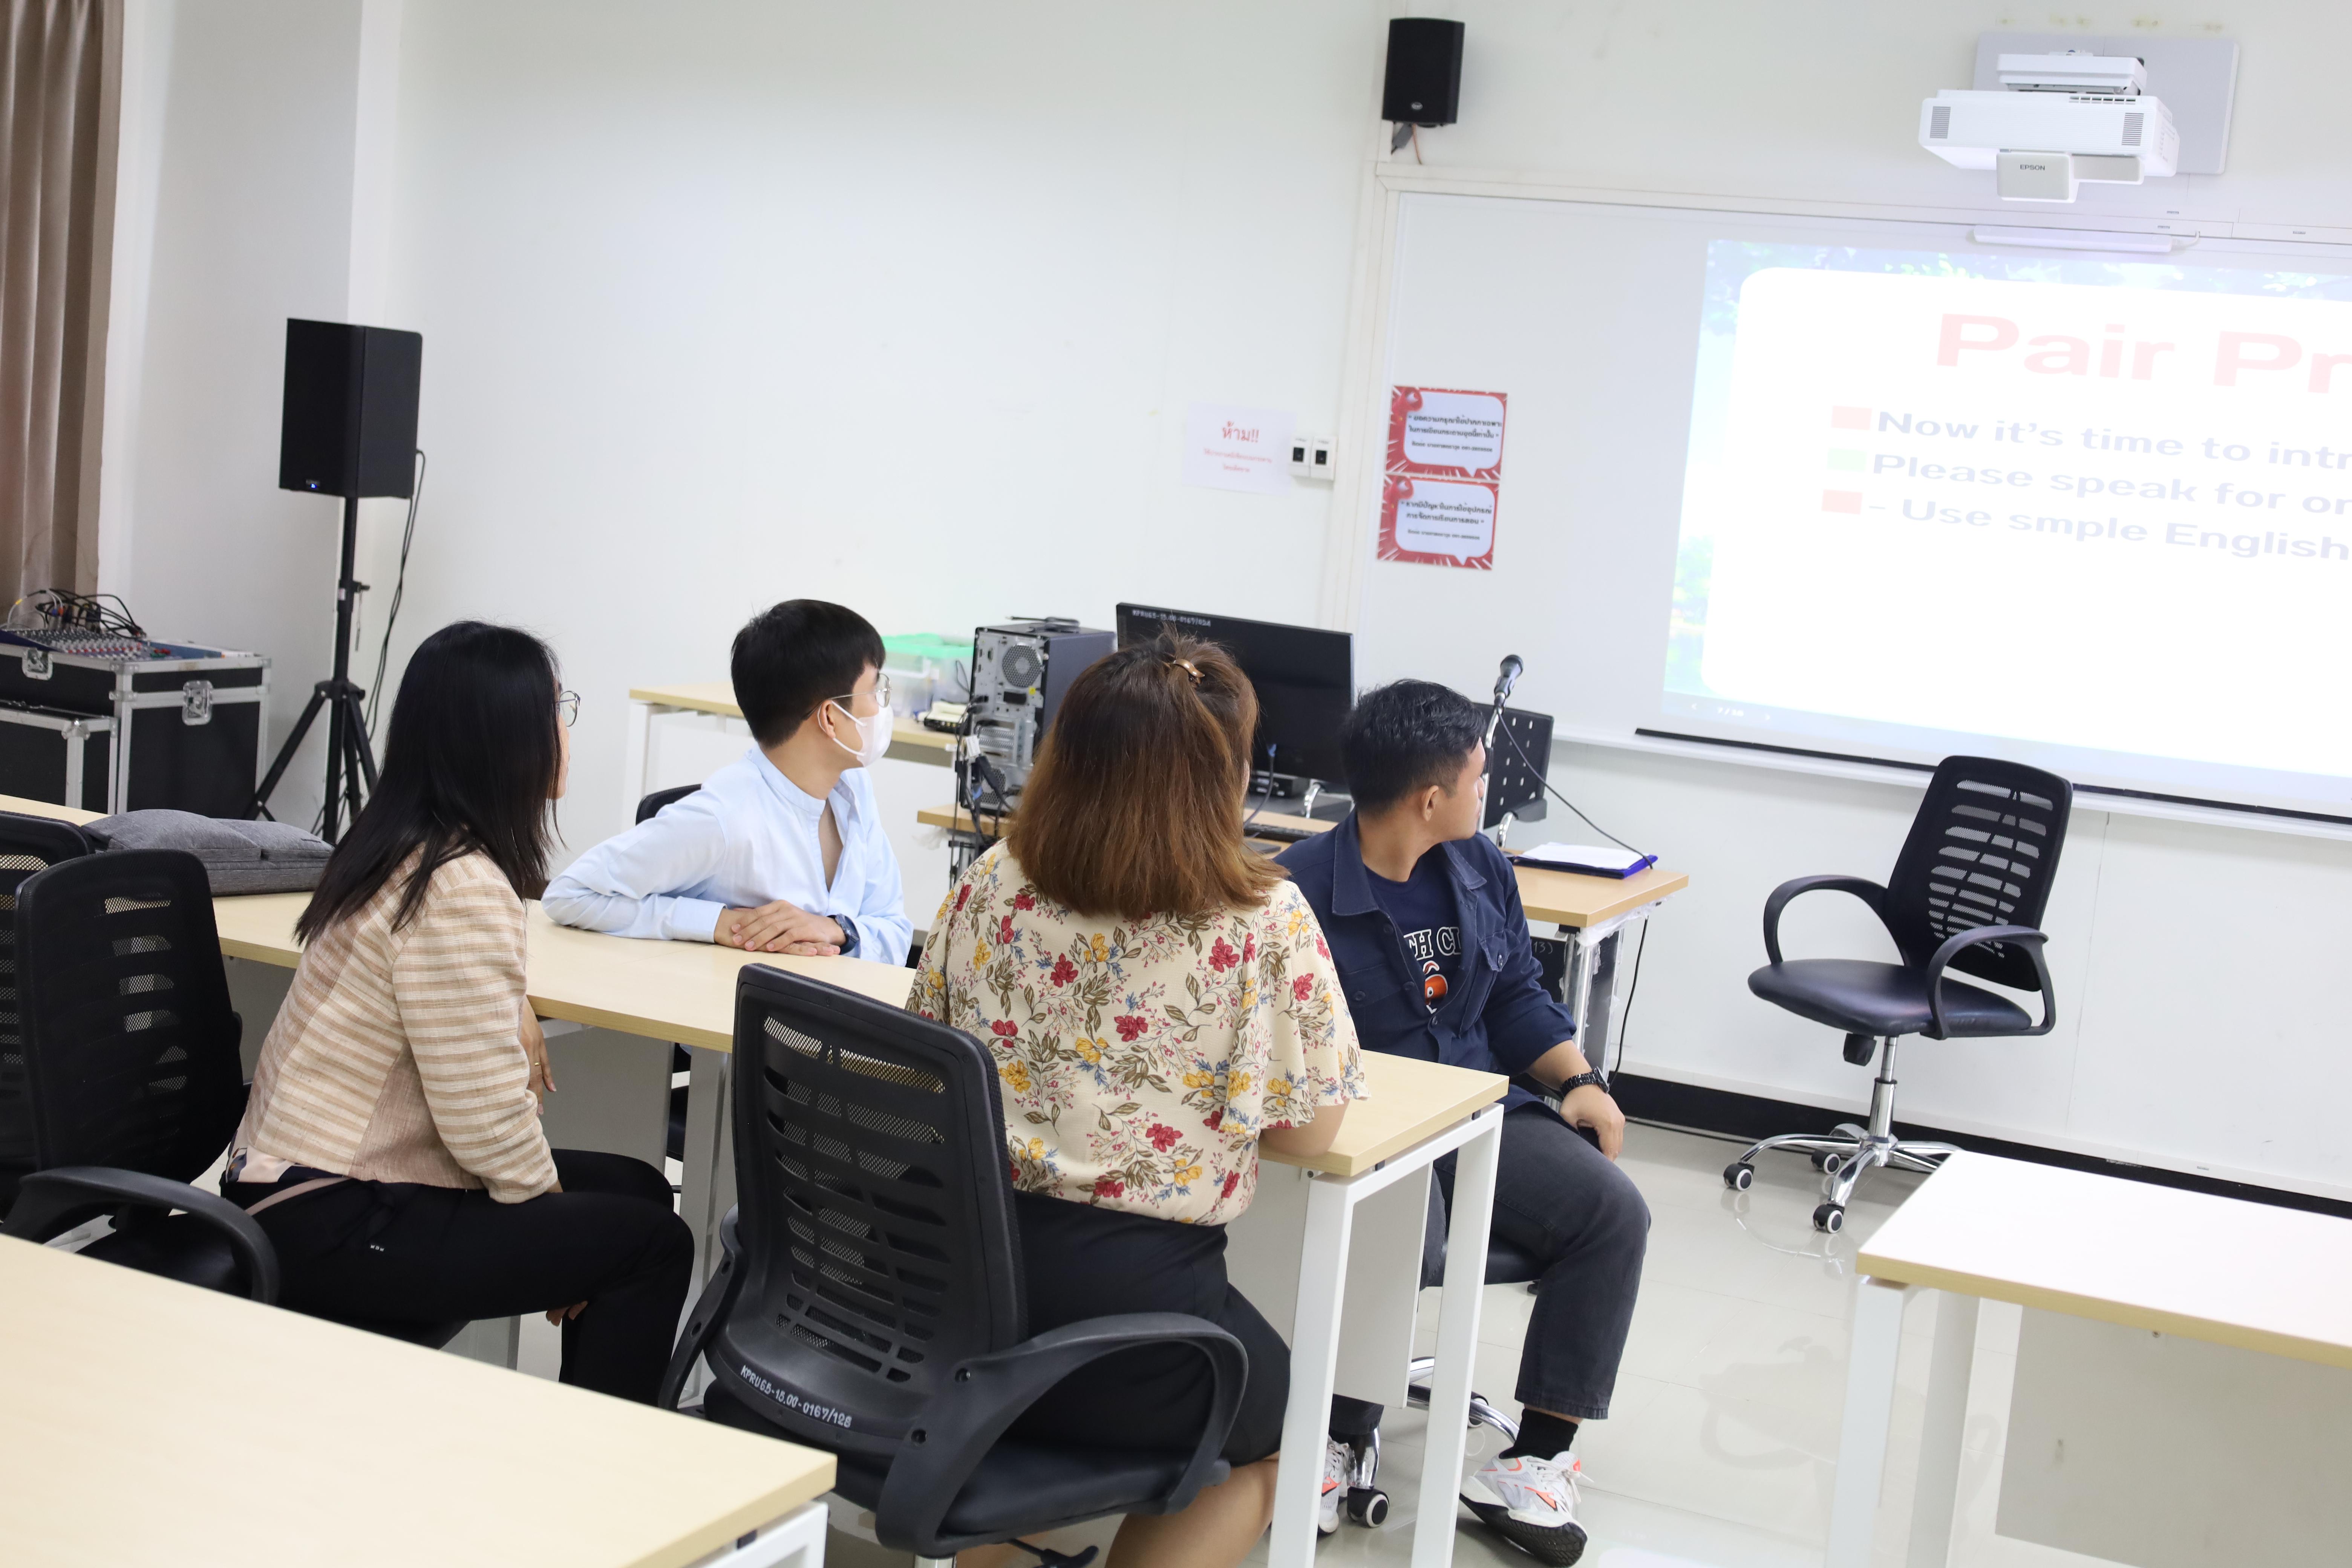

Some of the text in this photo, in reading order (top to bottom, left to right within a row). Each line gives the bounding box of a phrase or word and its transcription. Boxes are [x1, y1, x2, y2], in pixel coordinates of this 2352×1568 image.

[1936, 313, 2175, 381] Pair
[1222, 421, 1259, 443] ห้าม!!
[1878, 411, 1979, 439] Now
[2080, 428, 2184, 456] time
[2200, 437, 2251, 462] to
[1873, 453, 2033, 487] Please
[2049, 475, 2197, 502] speak
[2214, 482, 2286, 509] for
[1902, 499, 1992, 527] Use
[2008, 514, 2148, 542] smple
[2165, 522, 2350, 560] English
[1403, 929, 1434, 961] H
[740, 1364, 853, 1428] KPRU65-15.00-0167/128
